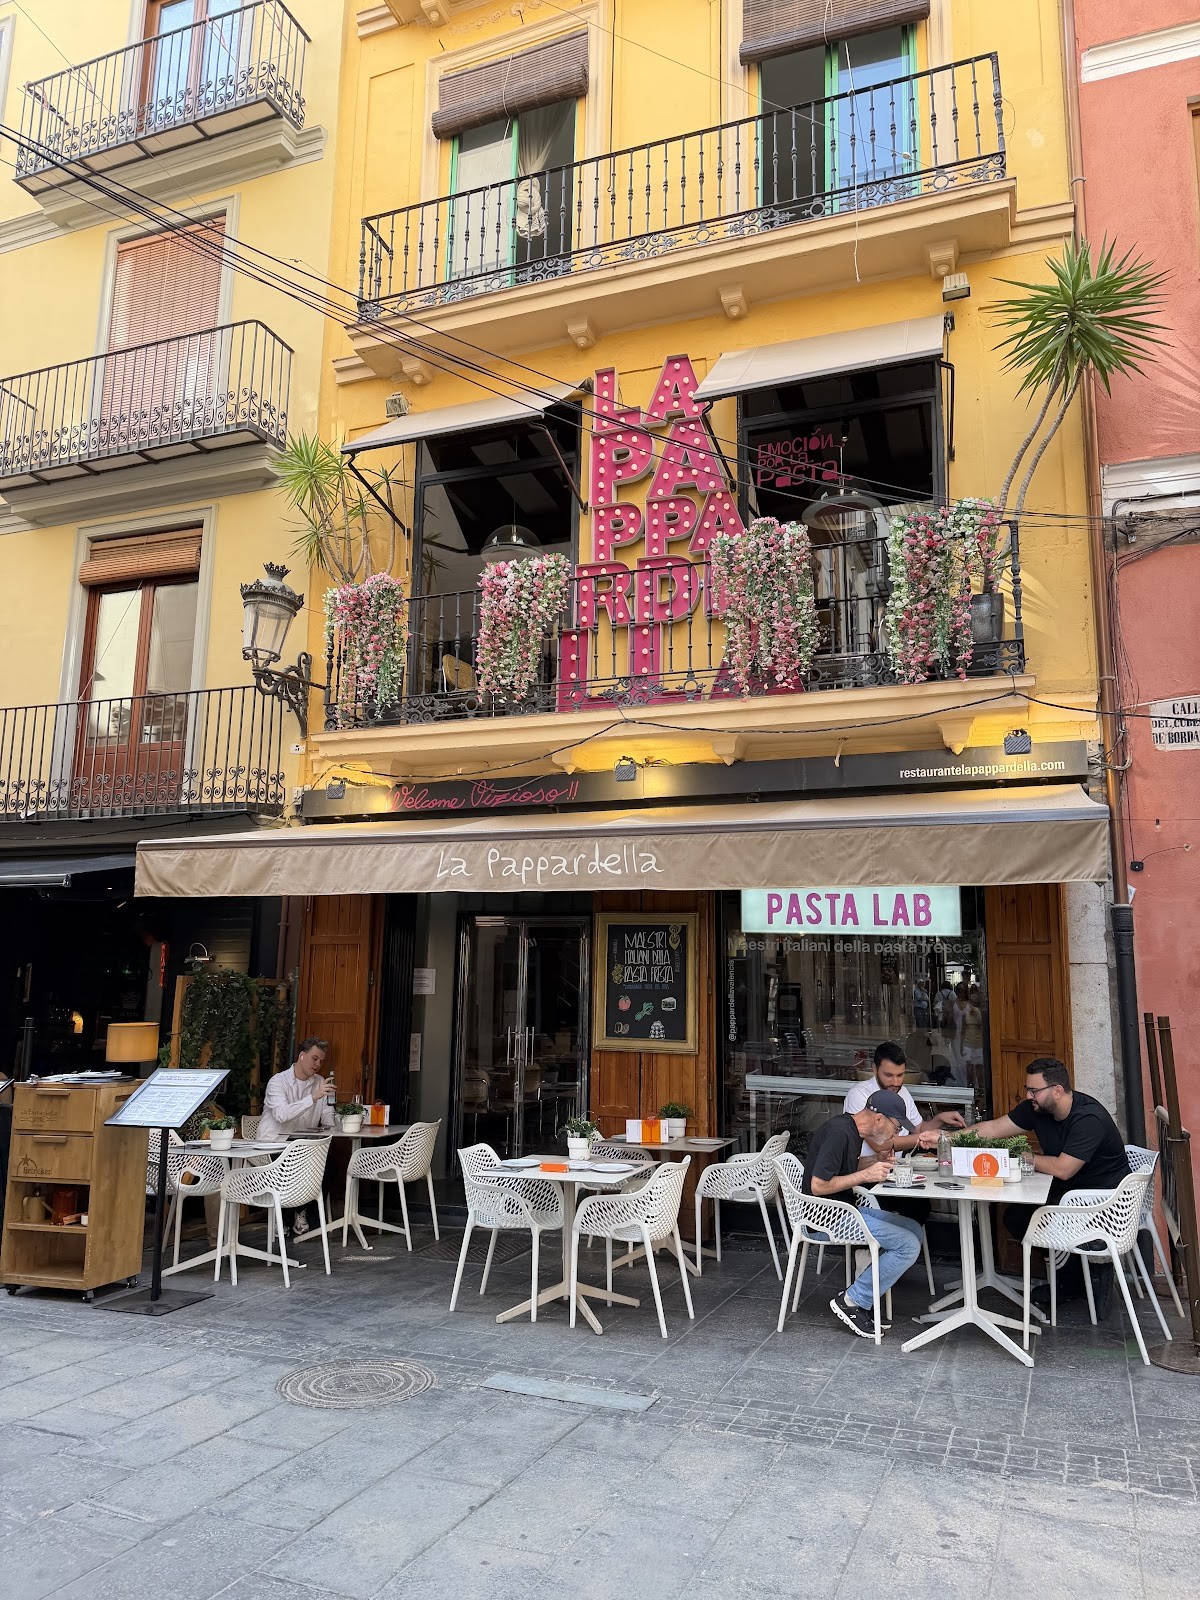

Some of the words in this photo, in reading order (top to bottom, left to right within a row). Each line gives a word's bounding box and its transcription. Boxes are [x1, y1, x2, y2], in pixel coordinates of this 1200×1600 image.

[595, 354, 709, 432] LA
[590, 416, 728, 508] PA
[757, 456, 784, 468] POR
[592, 490, 746, 562] PPA
[1151, 719, 1172, 728] DEL
[1152, 732, 1165, 744] DE
[899, 760, 1066, 778] restaurantelapappardella.com
[387, 784, 466, 811] Welcome
[436, 850, 473, 878] La
[487, 842, 665, 884] Pappardella
[767, 892, 859, 925] PASTA
[873, 893, 932, 926] LAB
[624, 931, 667, 949] MAESTRI
[727, 937, 780, 951] Maestri
[783, 938, 830, 953] italiani
[834, 938, 870, 953] della
[874, 939, 917, 956] pasta
[920, 940, 973, 954] fresca
[652, 949, 671, 965] DELLA
[624, 965, 648, 983] PASTA
[651, 965, 674, 984] FRESCA
